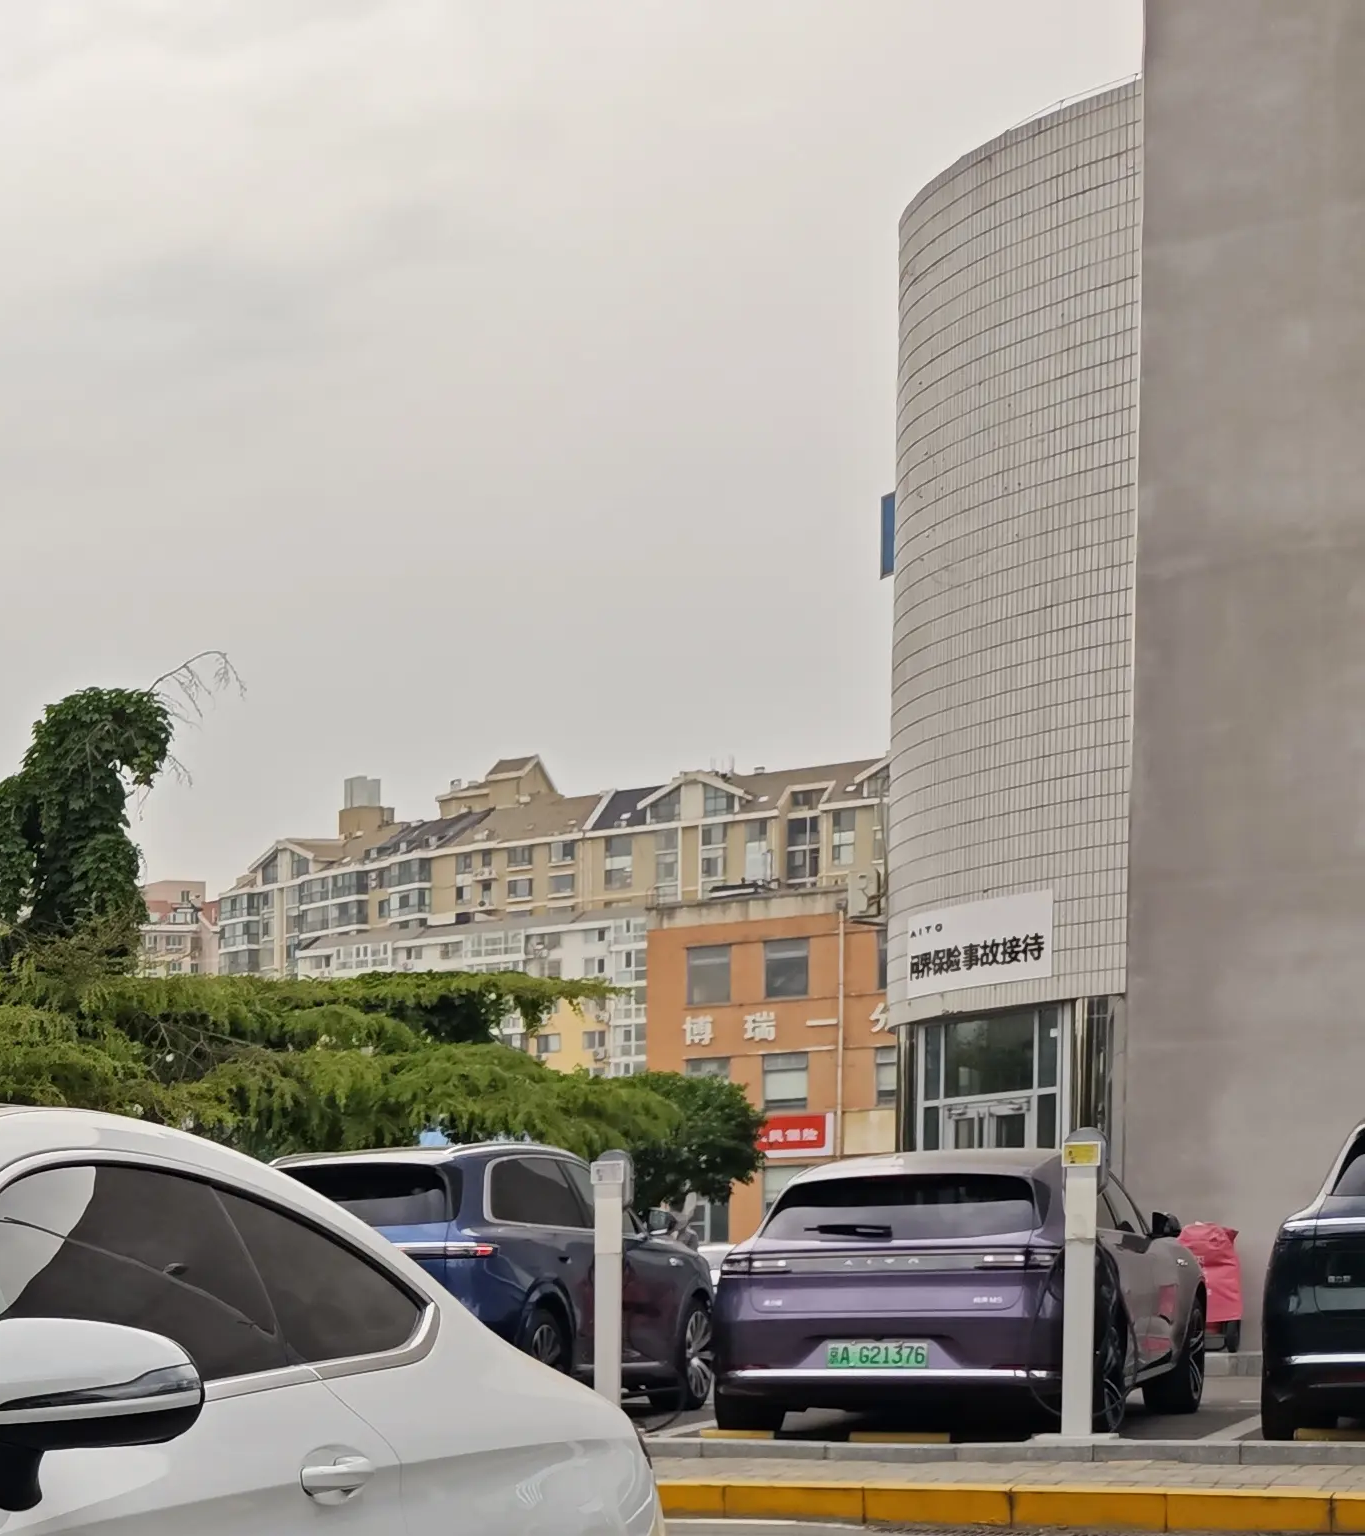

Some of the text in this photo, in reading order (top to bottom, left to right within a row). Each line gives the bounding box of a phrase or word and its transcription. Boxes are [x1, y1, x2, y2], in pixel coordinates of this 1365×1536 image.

[910, 923, 943, 938] AITO
[909, 932, 1045, 981] 问界保险事故接待
[761, 1128, 819, 1143] 民保险
